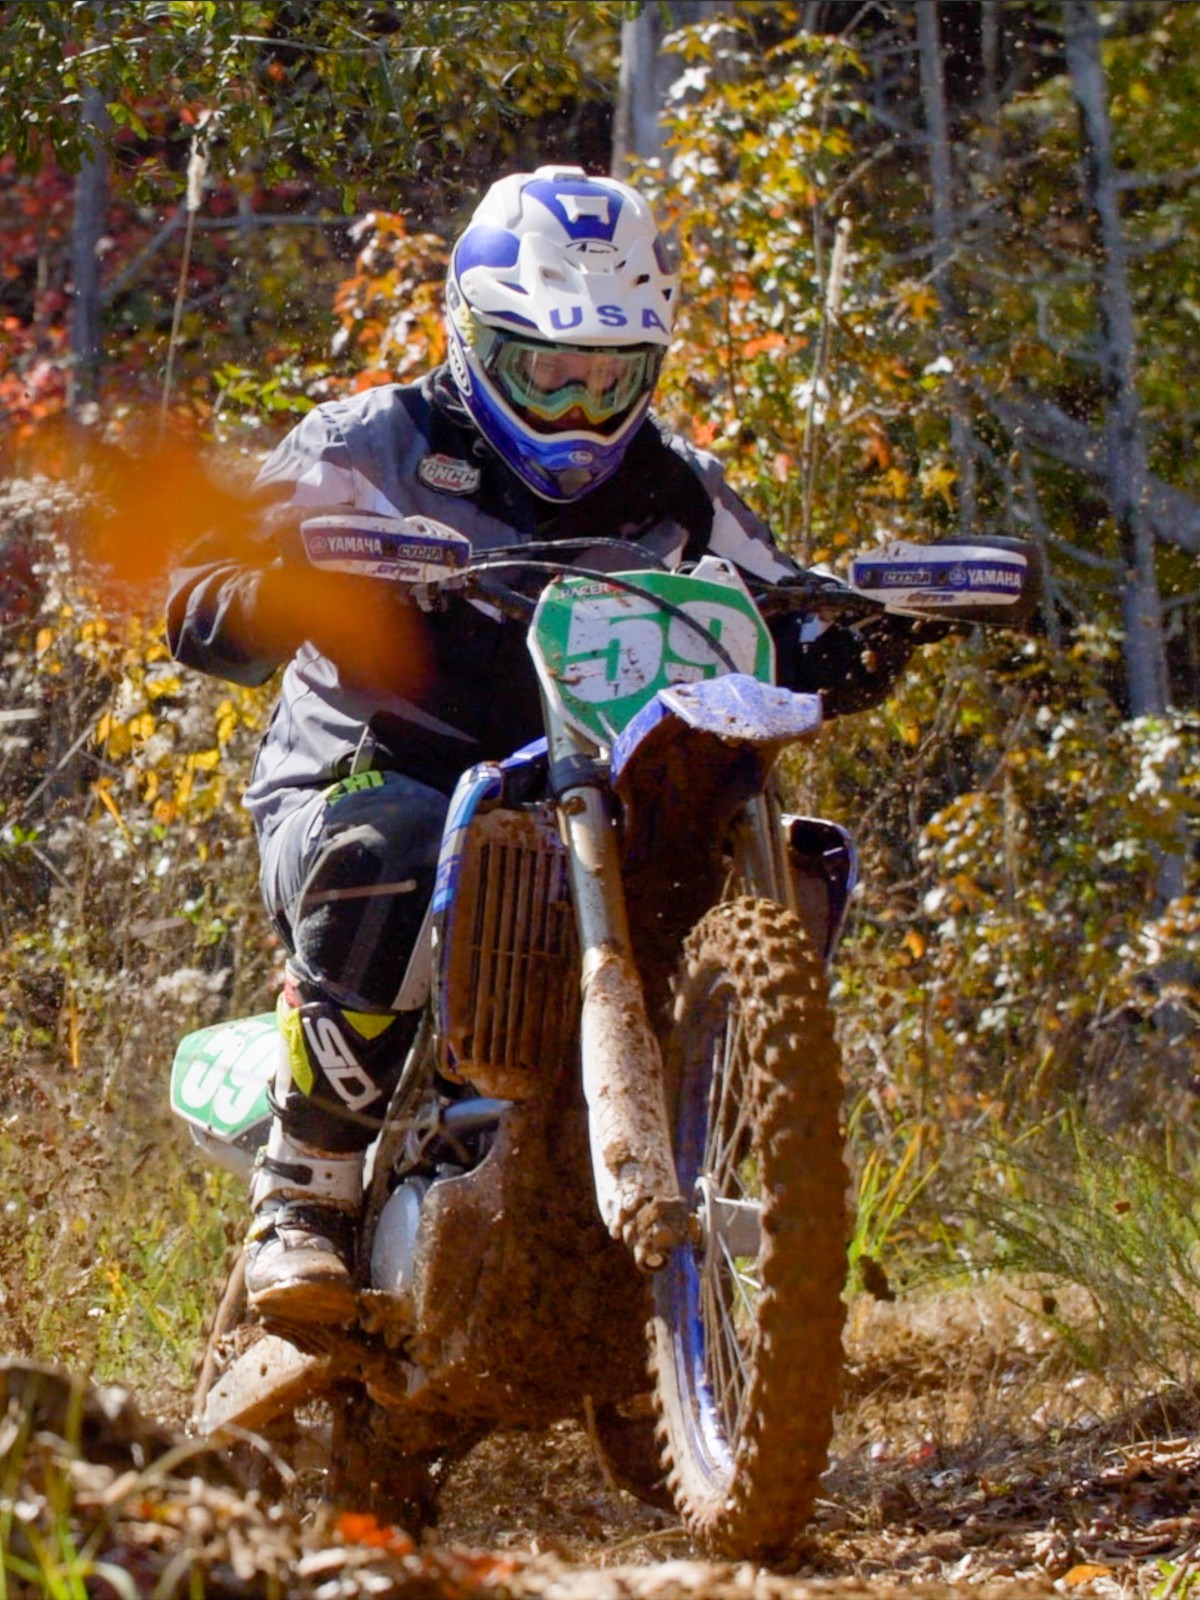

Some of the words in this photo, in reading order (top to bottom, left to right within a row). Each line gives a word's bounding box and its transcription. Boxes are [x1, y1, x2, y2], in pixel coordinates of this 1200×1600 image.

[550, 304, 668, 335] USA
[327, 536, 383, 555] YAMAHA
[968, 569, 1022, 588] YAMAHA
[564, 595, 758, 704] 59
